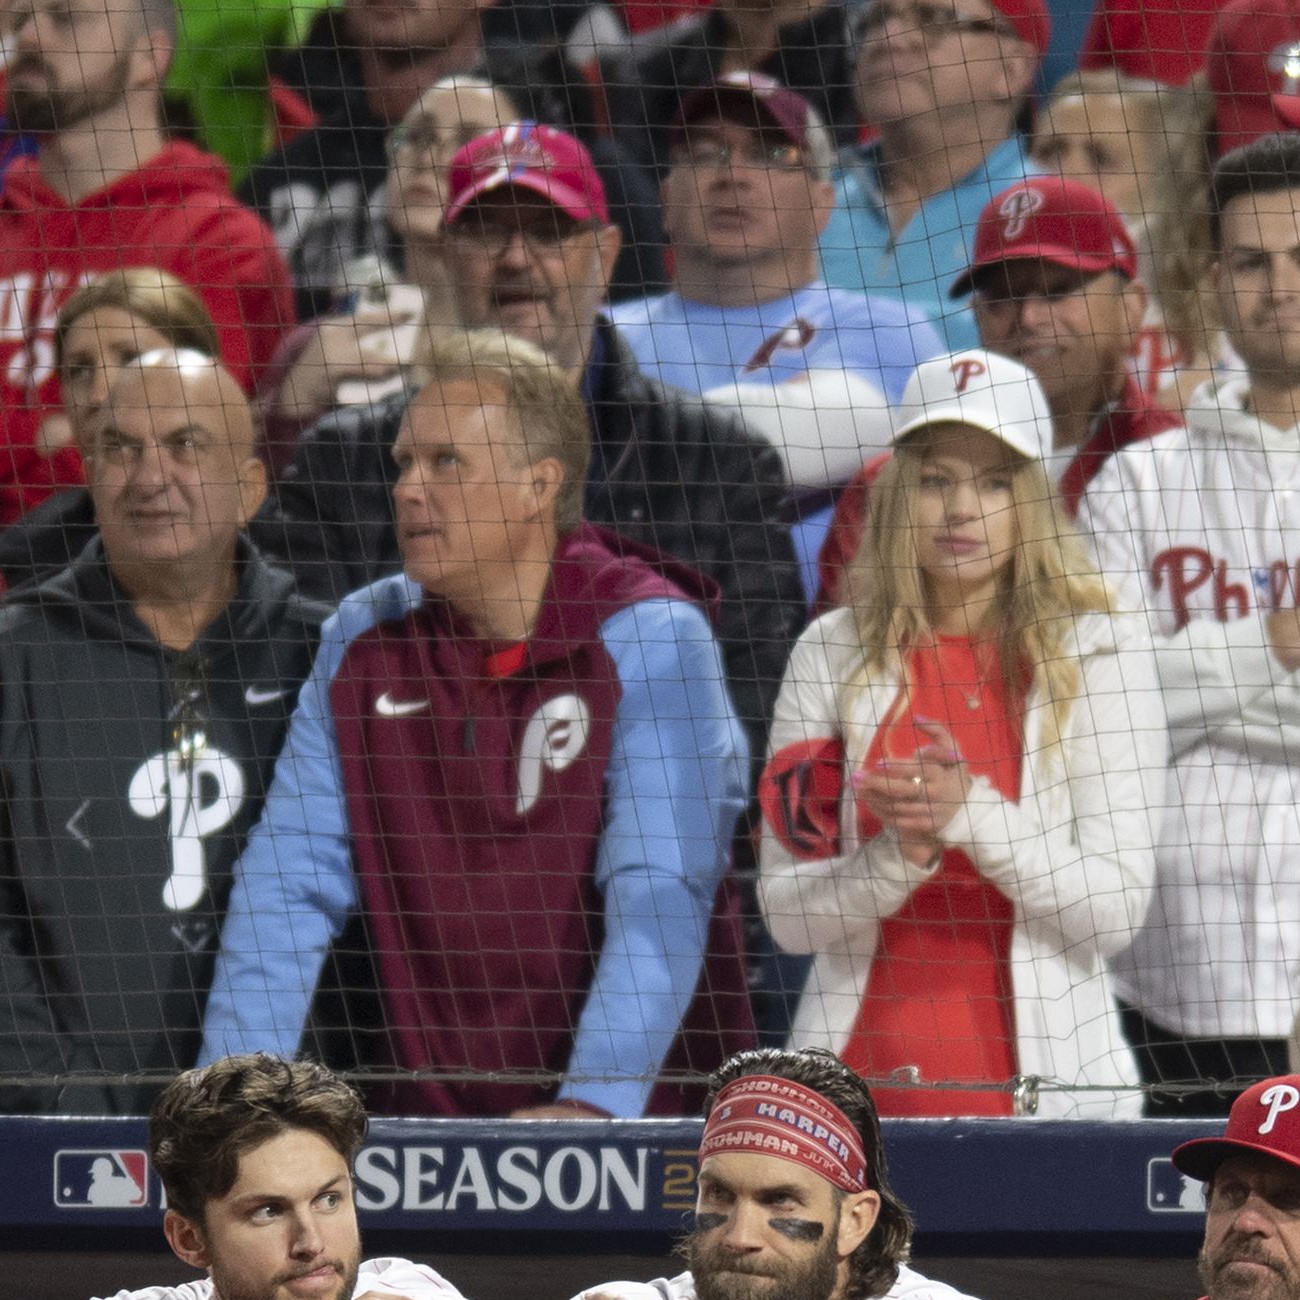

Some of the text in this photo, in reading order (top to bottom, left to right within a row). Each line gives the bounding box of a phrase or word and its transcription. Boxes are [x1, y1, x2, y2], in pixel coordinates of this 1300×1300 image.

[1001, 189, 1042, 240] P
[950, 360, 986, 393] P
[517, 693, 591, 816] P
[128, 746, 246, 912] P
[755, 1102, 850, 1163] HARPER
[1257, 1084, 1300, 1135] P
[354, 1146, 648, 1212] SEASON
